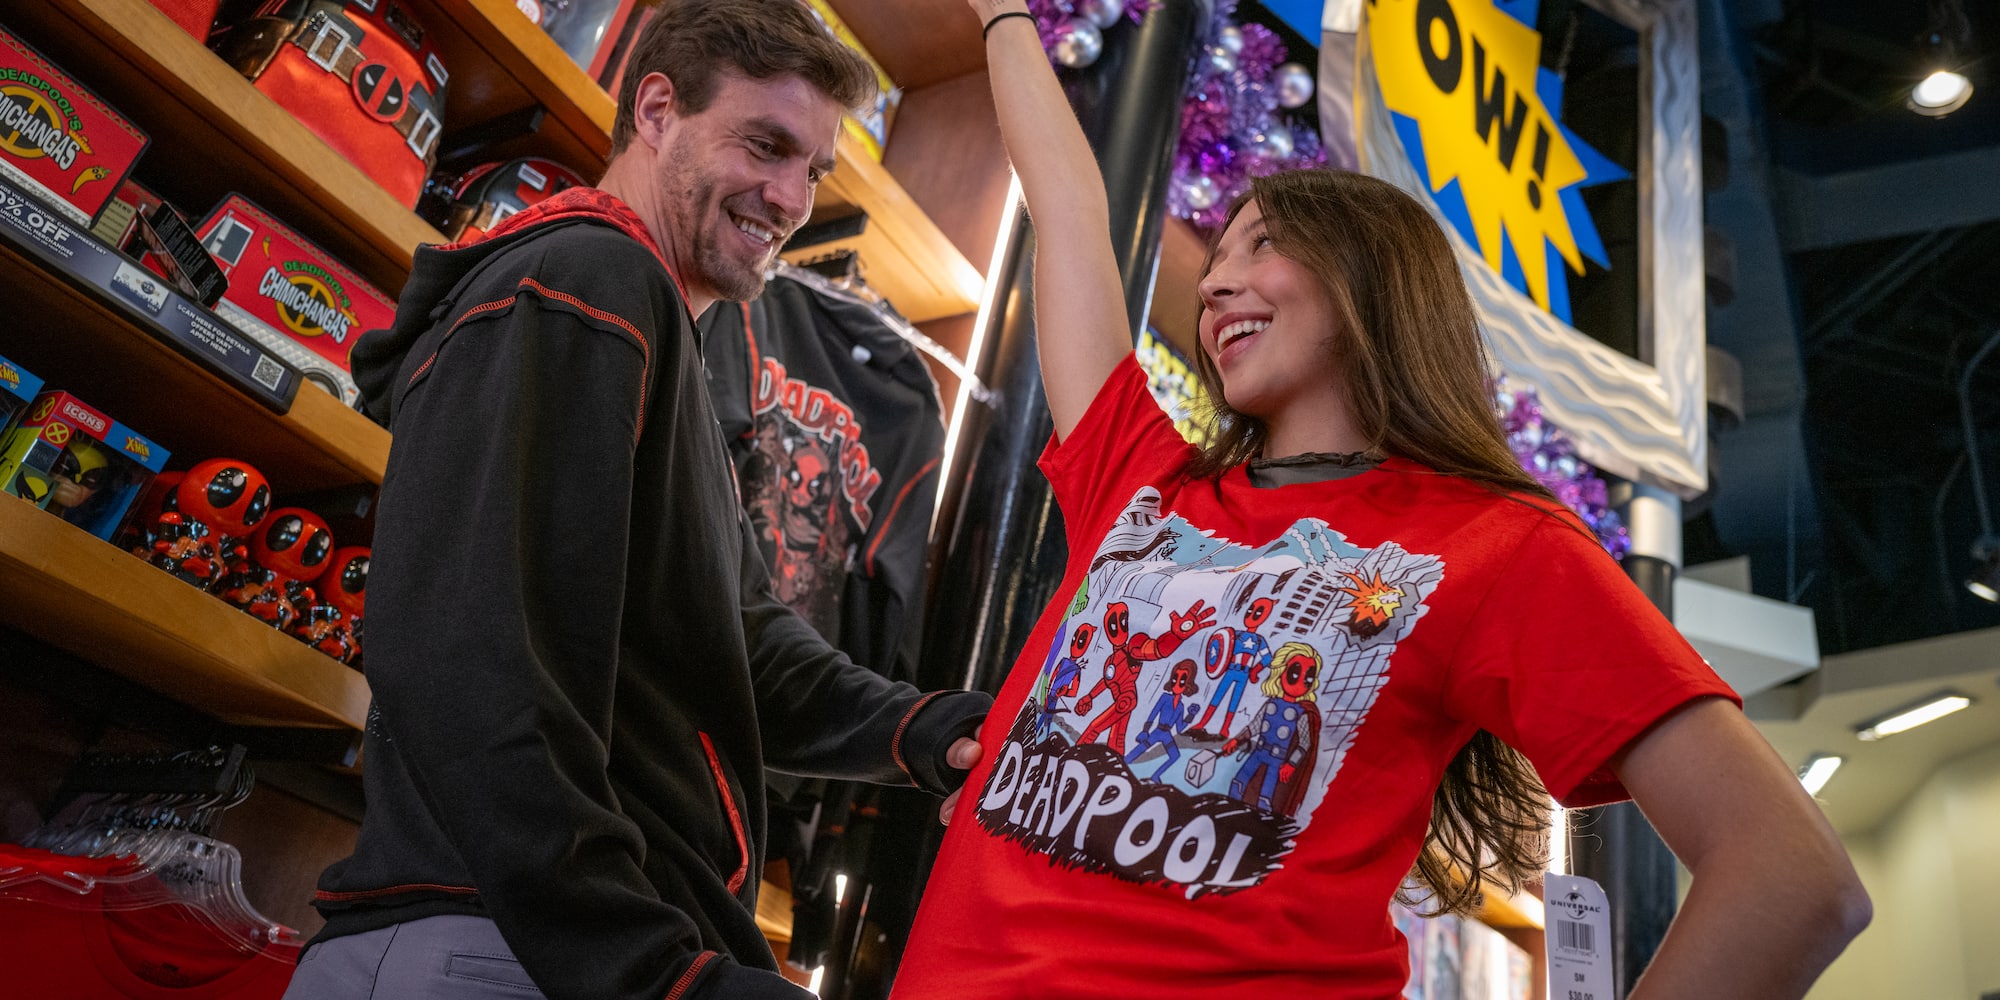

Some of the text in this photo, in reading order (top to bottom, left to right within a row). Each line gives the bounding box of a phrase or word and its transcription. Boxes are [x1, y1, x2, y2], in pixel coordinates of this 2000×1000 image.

[1369, 0, 1550, 211] OW!
[12, 192, 24, 203] VISA
[0, 208, 73, 256] UNIVERSAL MERCHANDISE
[27, 212, 71, 241] OFF
[283, 261, 351, 309] DEADPOOL'S
[258, 266, 352, 344] CHIMICHANGAS
[178, 304, 195, 318] SCAN
[195, 315, 213, 330] HERE
[212, 326, 226, 338] FOR
[190, 321, 215, 339] OFFERS
[190, 328, 210, 343] APPLY
[63, 402, 106, 432] ICONS
[756, 357, 882, 534] DADPOOL
[982, 741, 1263, 887] DEADPOOL
[1550, 899, 1601, 913] UNIVERSAL
[1574, 972, 1585, 982] SM
[1568, 990, 1594, 1000] $3000
